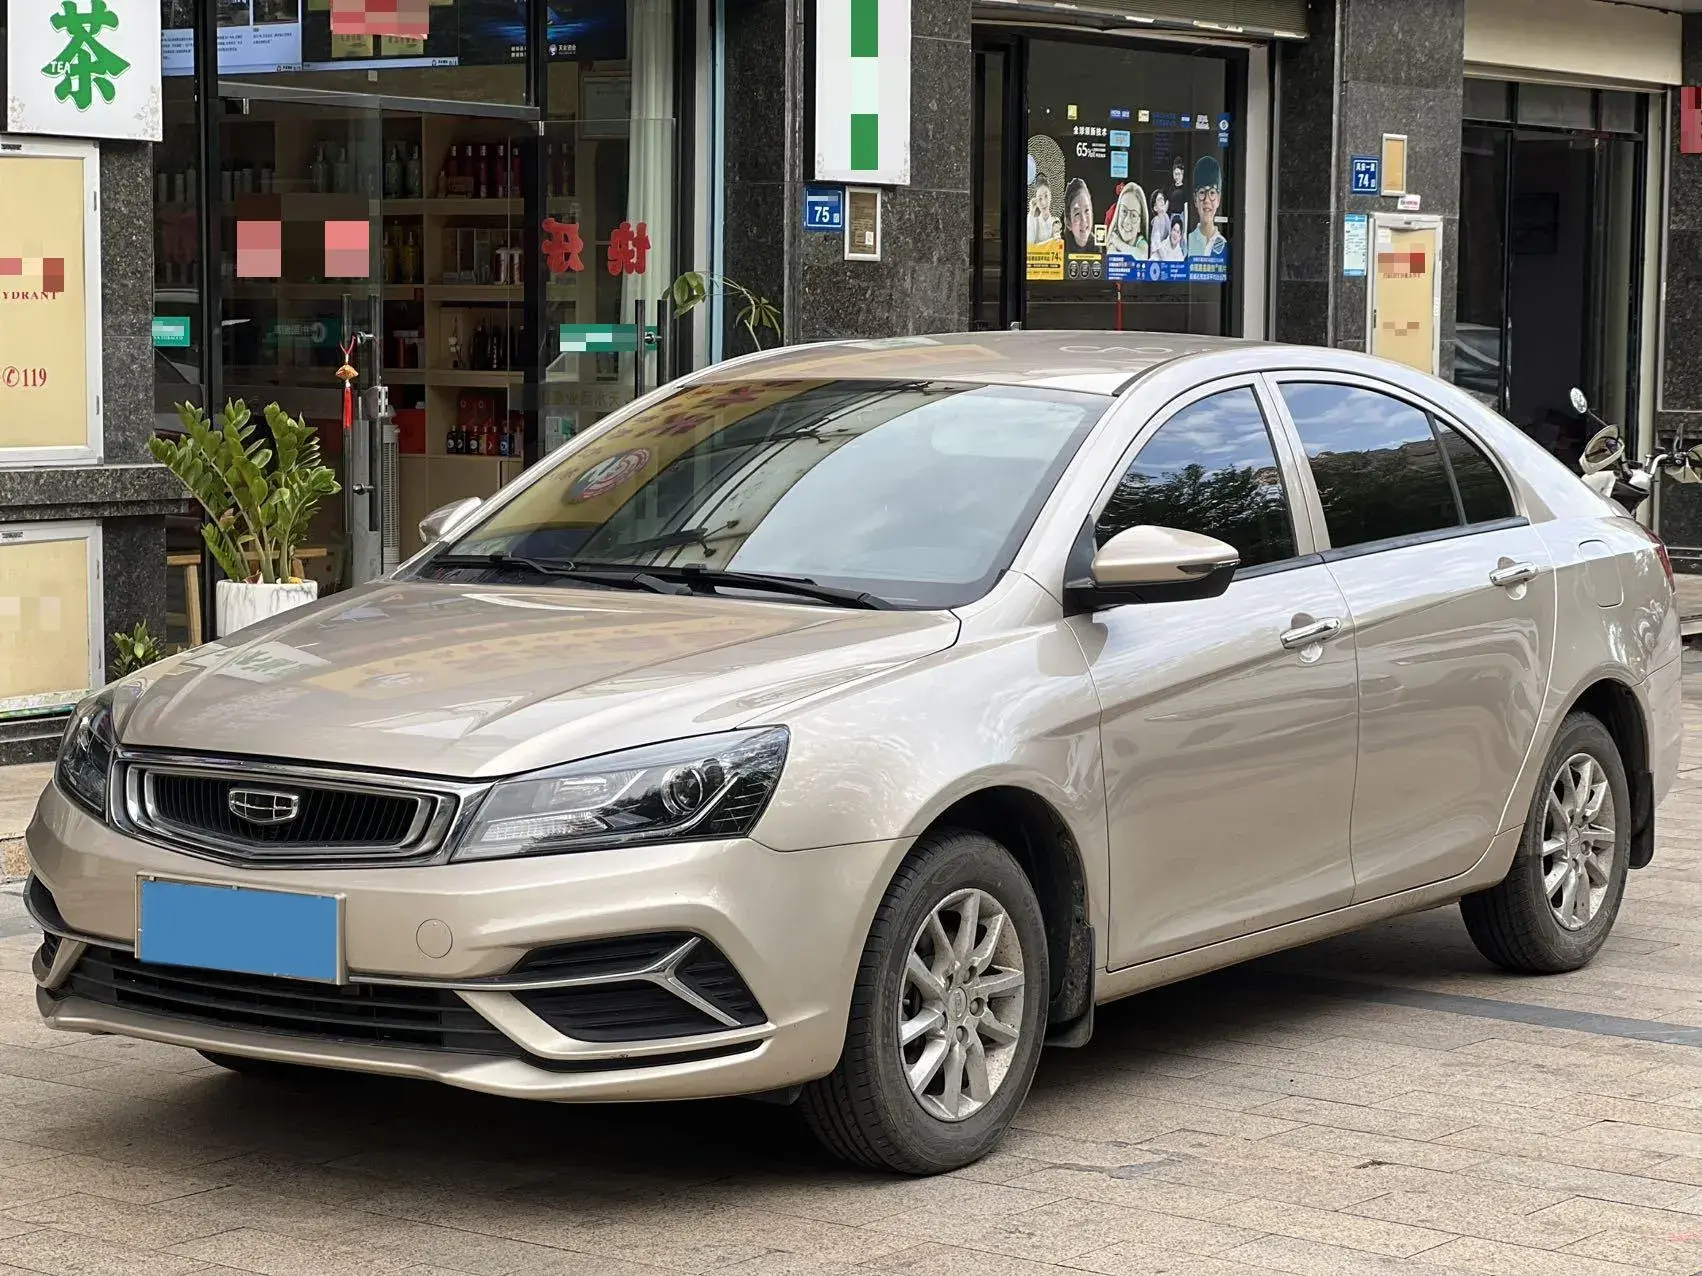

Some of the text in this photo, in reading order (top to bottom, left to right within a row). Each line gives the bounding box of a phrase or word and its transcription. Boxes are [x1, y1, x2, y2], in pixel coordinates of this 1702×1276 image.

[41, 0, 131, 112] 茶
[51, 61, 71, 74] TEA
[1358, 173, 1370, 187] 74
[814, 206, 830, 223] 75
[22, 367, 48, 387] 119
